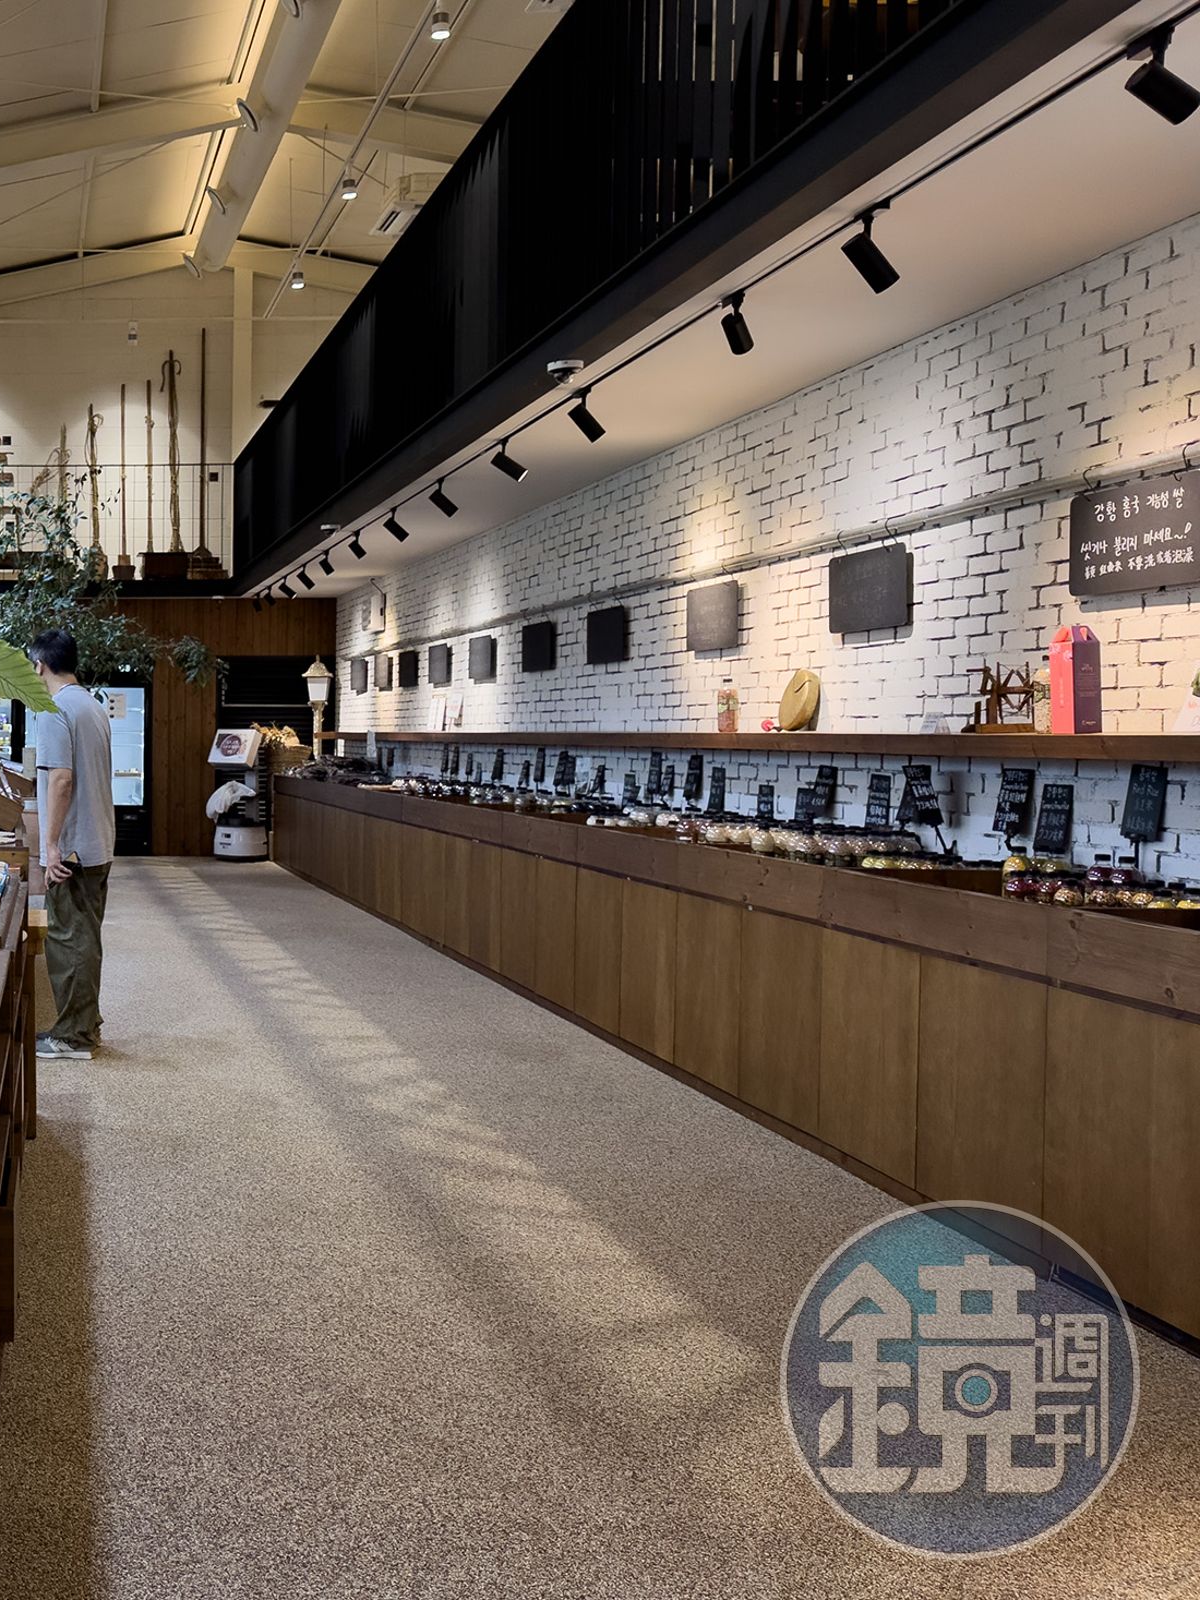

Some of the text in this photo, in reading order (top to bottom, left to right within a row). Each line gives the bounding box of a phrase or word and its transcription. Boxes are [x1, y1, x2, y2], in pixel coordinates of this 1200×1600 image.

[1094, 486, 1185, 522] 강황 홍국 기능성 쌀
[1080, 539, 1108, 561] 씻거나
[1113, 535, 1138, 557] 불리지
